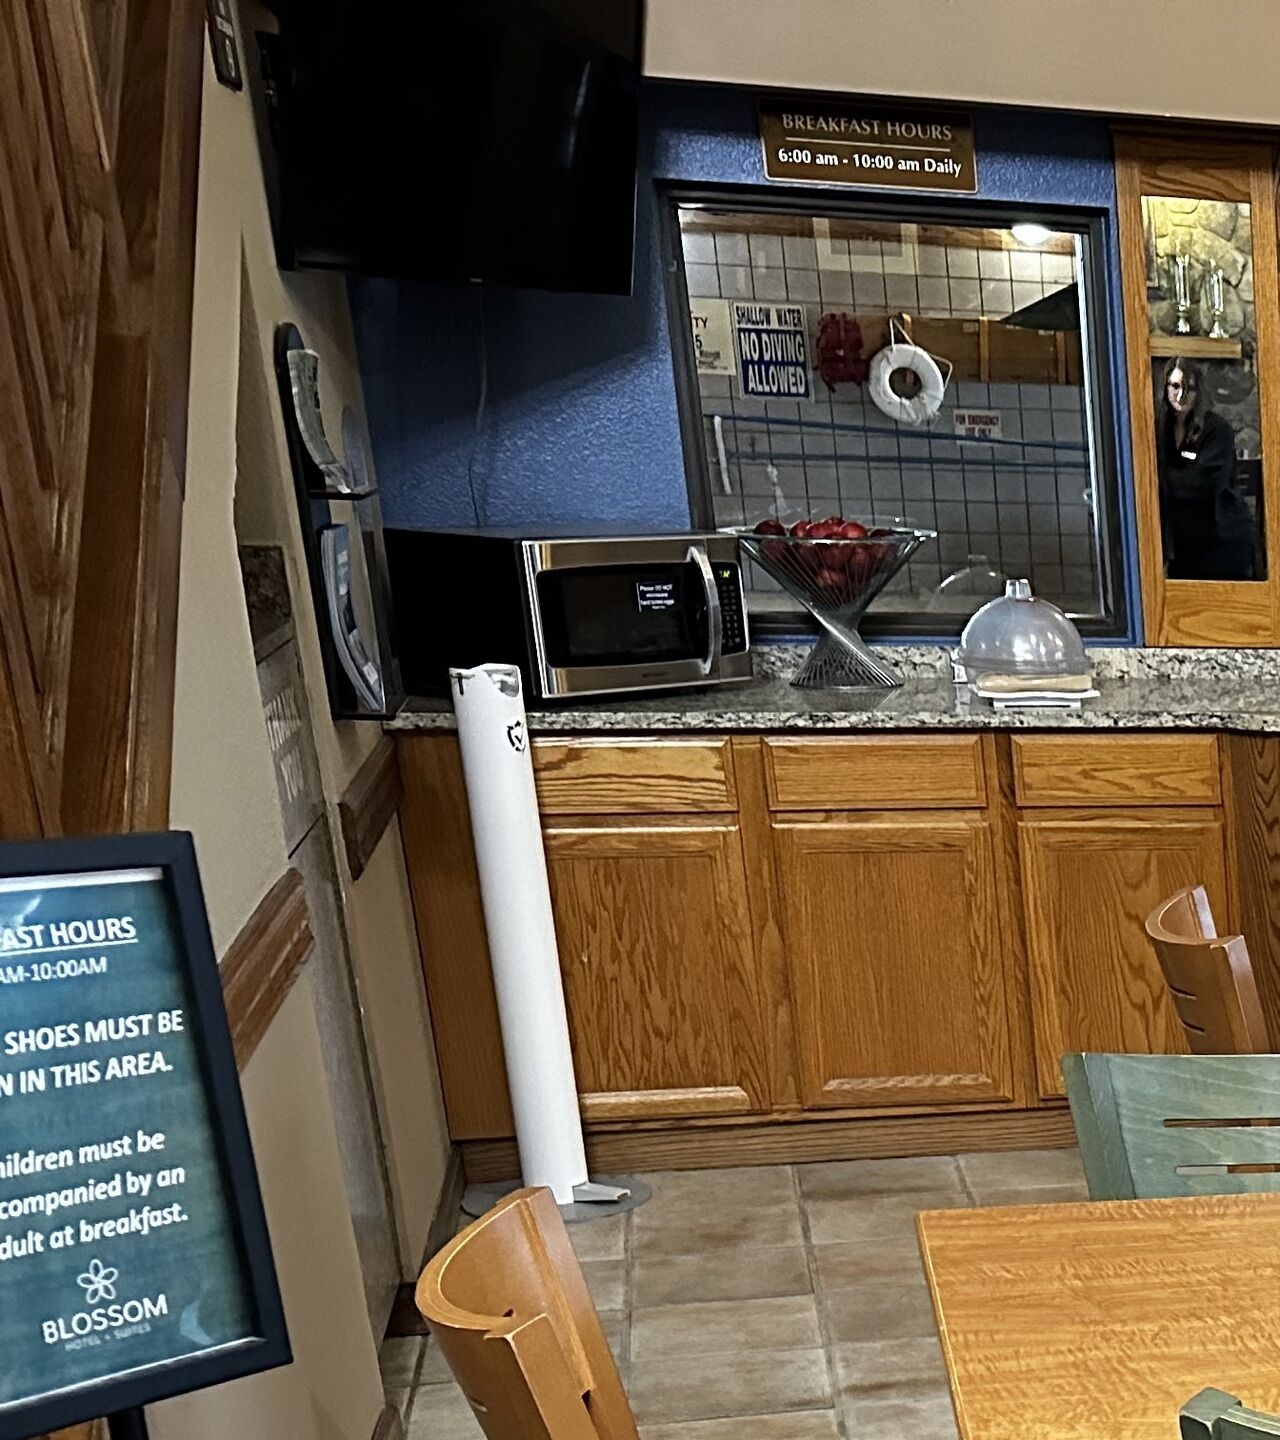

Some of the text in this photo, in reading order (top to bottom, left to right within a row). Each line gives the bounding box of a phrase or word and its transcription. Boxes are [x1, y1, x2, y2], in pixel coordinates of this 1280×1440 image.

[782, 113, 952, 141] BREAKFAST HOURS
[778, 148, 812, 164] 6:00
[815, 153, 839, 166] am
[852, 153, 894, 169] 10:00
[898, 158, 920, 172] am
[924, 158, 962, 178] Daily
[736, 305, 803, 328] SHALLOW WATER
[740, 331, 805, 363] NO DIVING
[748, 364, 806, 394] ALLOWED
[0, 916, 137, 951] AST HOURS
[4, 1009, 184, 1055] SHOES MUST BE
[20, 1067, 46, 1094] IN
[50, 1060, 101, 1088] THIS
[105, 1051, 174, 1080] AREA.
[79, 1135, 133, 1164] must
[137, 1129, 166, 1153] be
[126, 1170, 152, 1197] by
[157, 1166, 186, 1188] an
[0, 1202, 189, 1261] dult at breakfast.
[42, 1293, 169, 1344] BLOSSOM
